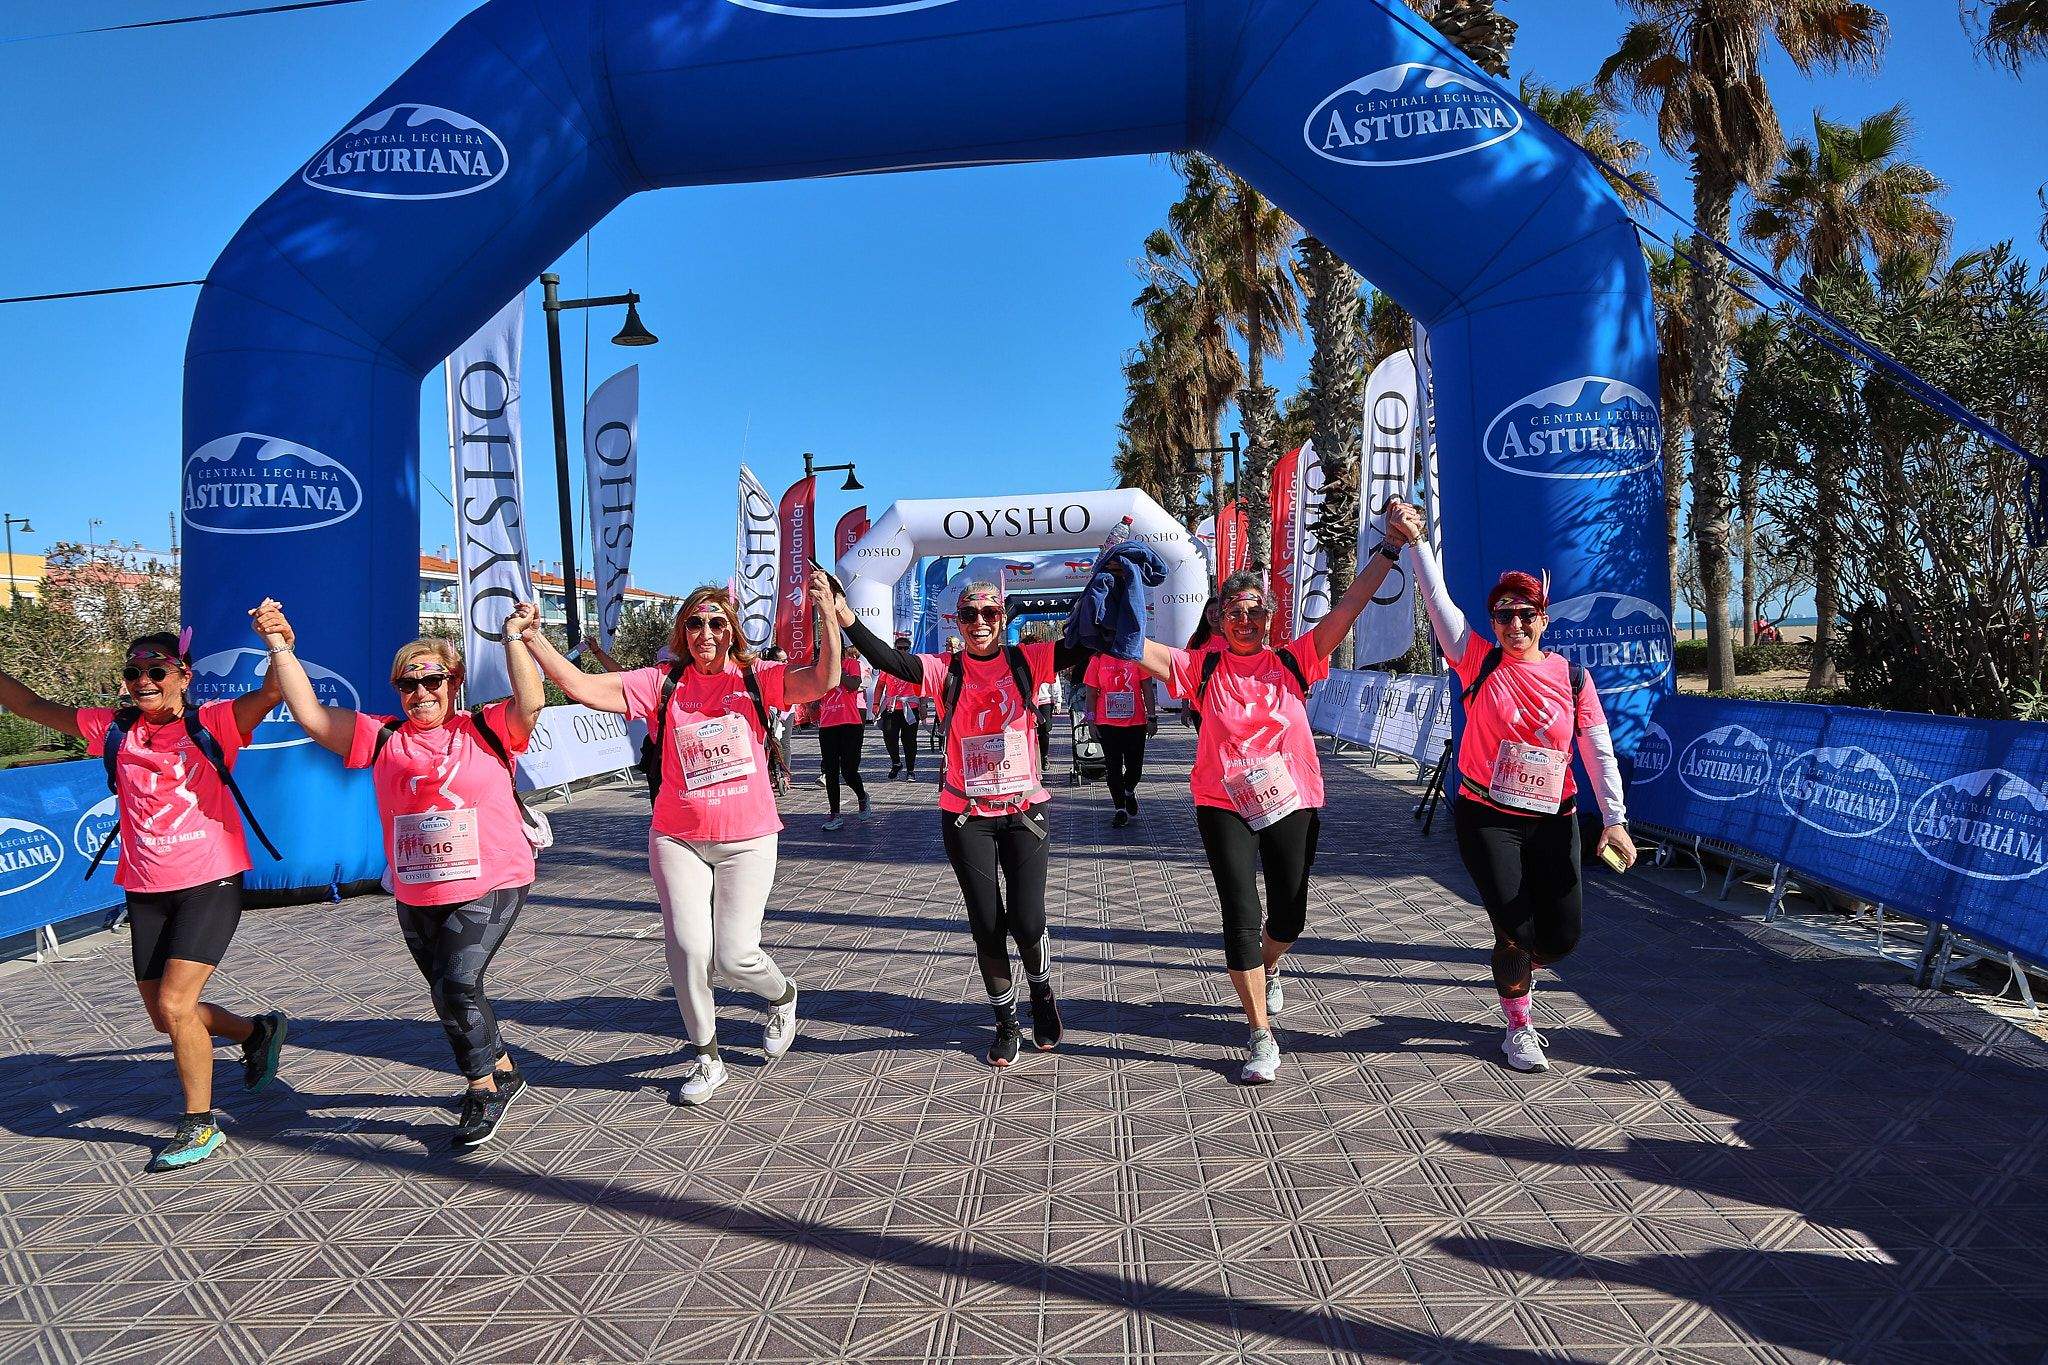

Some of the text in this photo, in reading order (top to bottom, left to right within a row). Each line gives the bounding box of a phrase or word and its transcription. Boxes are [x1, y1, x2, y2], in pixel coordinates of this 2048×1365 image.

[1355, 93, 1498, 113] CENTRAL LECHERA
[1322, 106, 1513, 150] ASTURIANA
[345, 132, 483, 149] CENTRAL LECHERA
[311, 147, 493, 179] ASTURIANA
[1530, 411, 1601, 426] CENTRAL
[1498, 421, 1659, 461] ASTURIANA
[198, 467, 339, 482] CENTRAL LECHERA
[184, 473, 347, 512] ASTURIANA
[459, 360, 522, 643] OYSHO
[943, 504, 1091, 540] OYSHO
[857, 547, 901, 557] OYSHO
[1228, 520, 1237, 575] antander
[741, 490, 776, 647] OYSHO
[788, 502, 805, 660] Sports Santander
[1022, 598, 1072, 607] VOLV
[1161, 593, 1204, 605] OYSHO
[1542, 624, 1666, 640] CENTRAL LECHERA
[573, 712, 628, 744] OYSHO
[704, 744, 730, 759] 016
[987, 760, 1011, 772] 016
[1519, 772, 1546, 787] 016
[708, 789, 717, 797] DE
[718, 788, 727, 797] LA
[1255, 785, 1279, 804] 016
[422, 841, 453, 855] 016
[0, 843, 58, 874] RIANA
[405, 872, 431, 880] OYSHO
